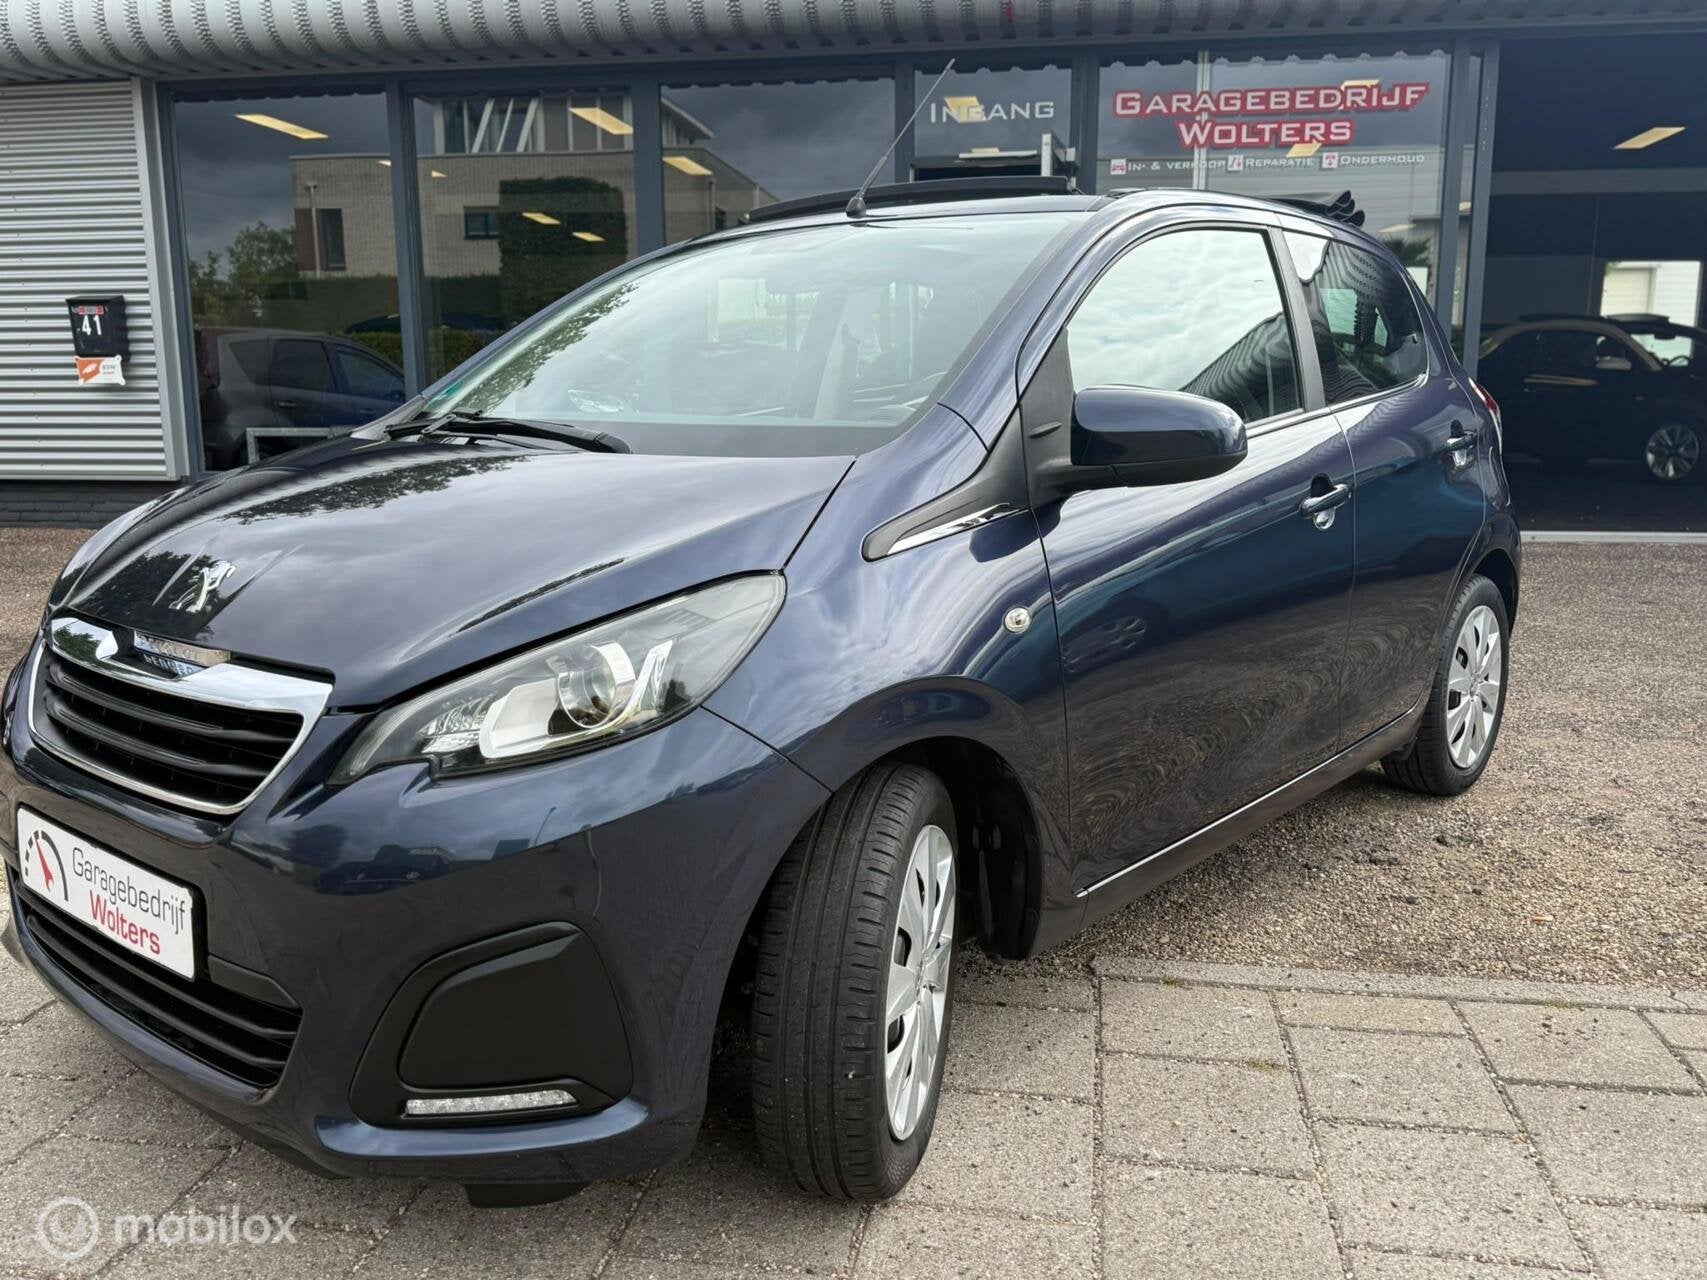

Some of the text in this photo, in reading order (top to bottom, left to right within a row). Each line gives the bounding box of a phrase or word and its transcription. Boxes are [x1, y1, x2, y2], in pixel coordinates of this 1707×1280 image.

[1114, 84, 1428, 116] GARAGEBEDRIJF
[1178, 120, 1352, 146] WOLTERS
[1151, 161, 1161, 170] &
[81, 314, 102, 336] 41
[72, 846, 186, 935] Garagebedrijf
[89, 889, 161, 955] Wolters
